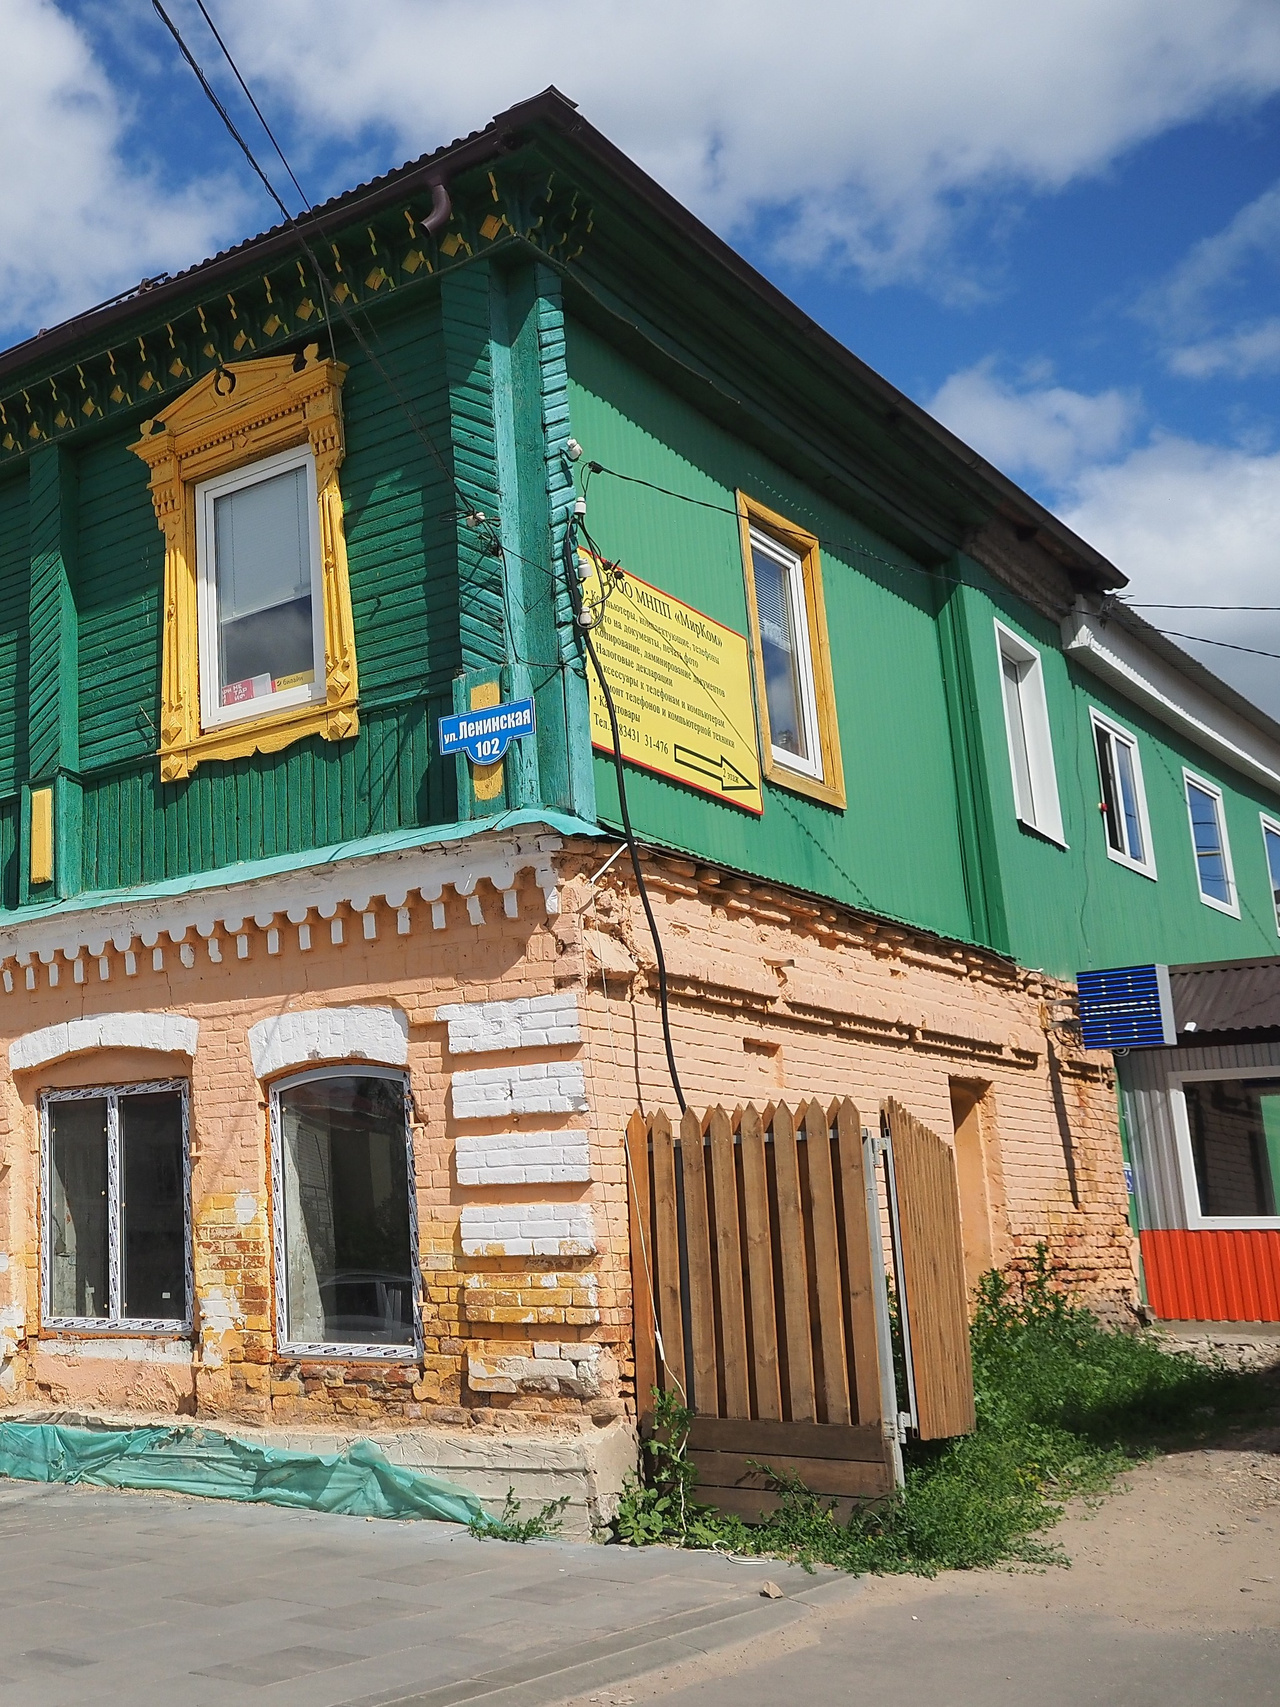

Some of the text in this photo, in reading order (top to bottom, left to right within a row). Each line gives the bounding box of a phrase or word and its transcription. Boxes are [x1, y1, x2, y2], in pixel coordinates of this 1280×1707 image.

[591, 590, 638, 624] Копьютеры,
[692, 644, 720, 665] телефоны
[592, 607, 612, 624] Фто
[614, 620, 622, 630] на
[624, 624, 662, 651] документы,
[684, 652, 699, 668] фото
[635, 586, 672, 620] МНПП
[674, 610, 722, 648] «МирКом»
[594, 626, 642, 658] Копирование,
[644, 650, 692, 680] ламинирование
[596, 642, 674, 687] Налоговые декларации
[598, 661, 725, 728] ксессуары к телефонам и компьютерам
[599, 695, 640, 723] Кацтовары
[444, 708, 531, 744] ул. Ленинская
[619, 723, 640, 743] 83431
[644, 734, 669, 755] 31-476
[626, 691, 660, 714] телефонов
[662, 708, 666, 716] и
[668, 710, 712, 738] компьютерной
[712, 731, 735, 748] техники
[475, 738, 500, 758] 102
[722, 768, 740, 784] 2 этаж
